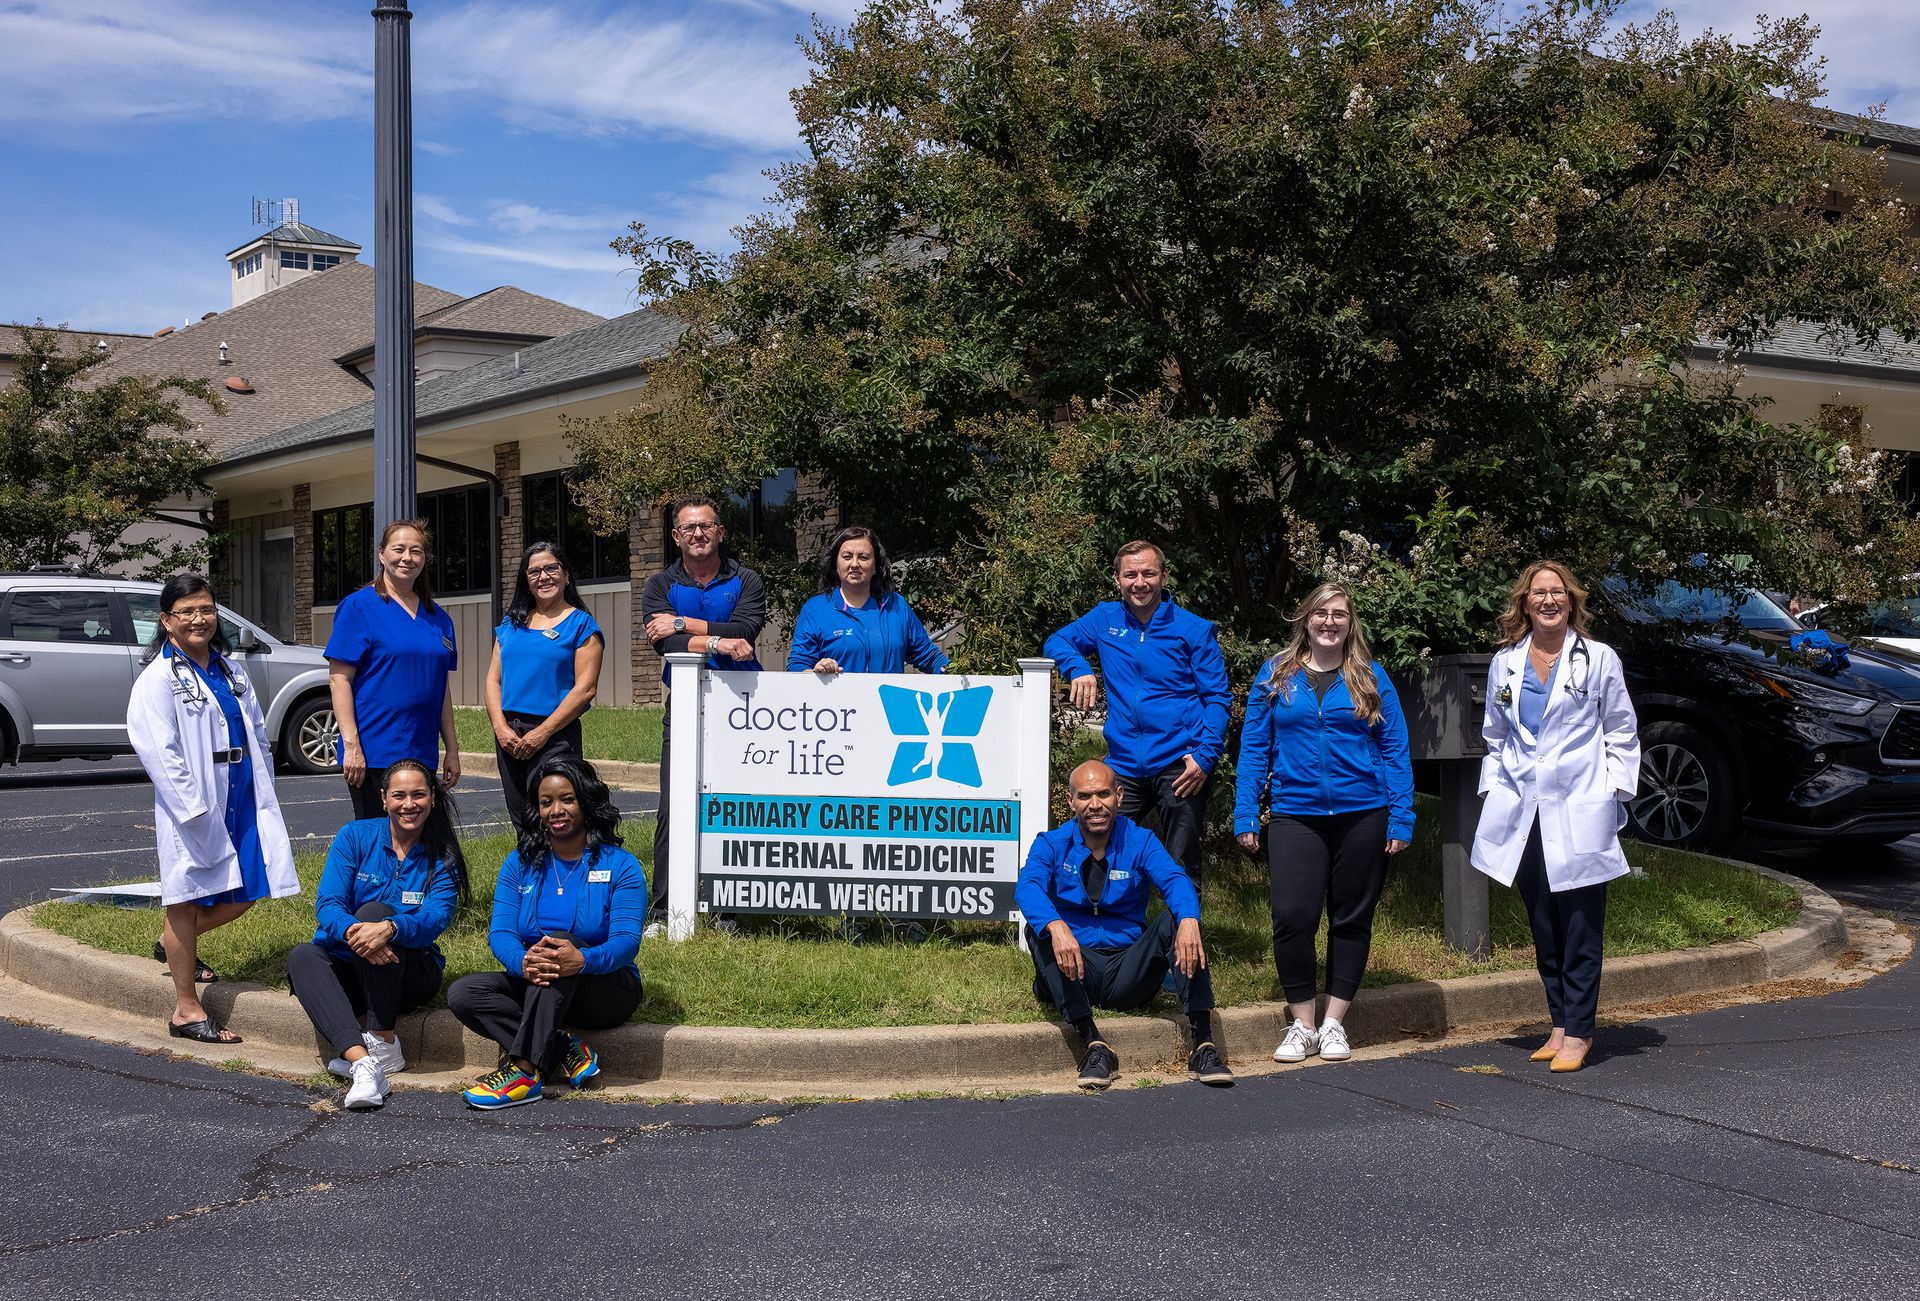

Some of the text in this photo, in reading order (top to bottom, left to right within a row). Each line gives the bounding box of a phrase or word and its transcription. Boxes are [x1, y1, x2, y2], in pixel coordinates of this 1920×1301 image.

[728, 691, 857, 732] doctor
[741, 742, 780, 765] for
[787, 739, 845, 776] life
[707, 800, 1012, 834] PRIMARY CARE PHYSICIAN
[722, 839, 995, 874] INTERNAL MEDICINE
[712, 879, 995, 915] MEDICAL WEIGHT LOSS
